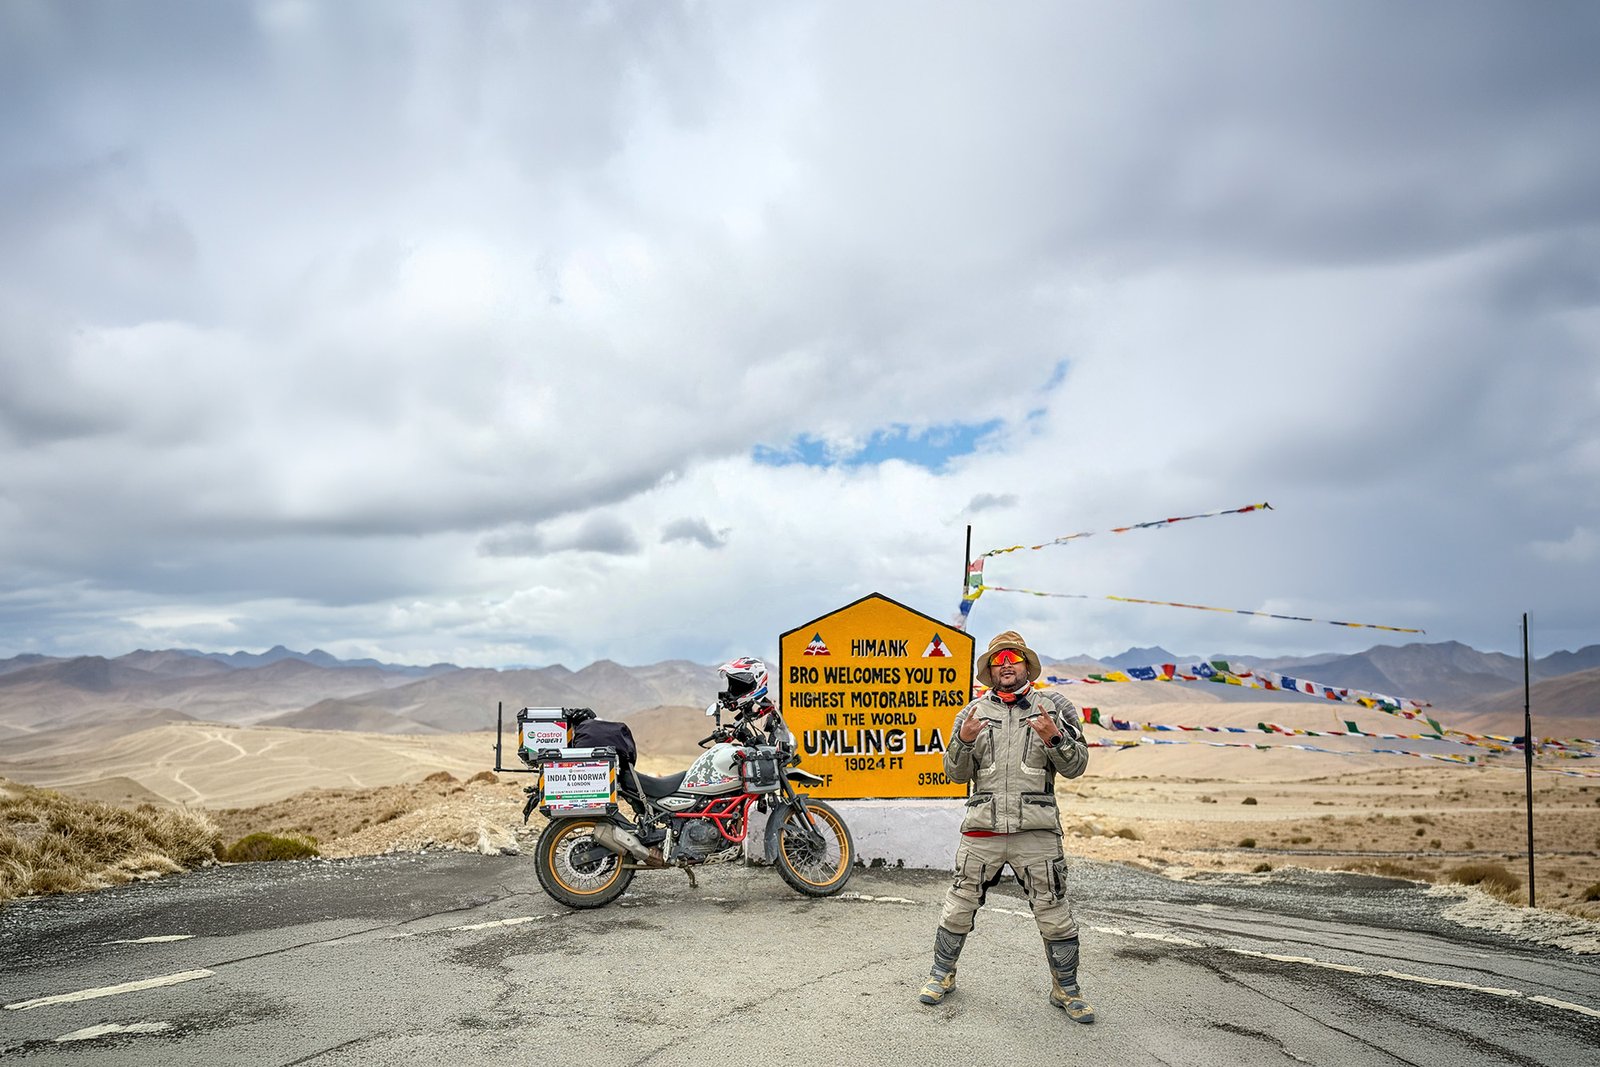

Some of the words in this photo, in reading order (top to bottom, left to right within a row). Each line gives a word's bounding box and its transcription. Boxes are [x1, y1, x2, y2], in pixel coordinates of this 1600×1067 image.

[851, 639, 908, 657] HIMANK
[790, 667, 818, 684] BRO
[824, 667, 900, 684] WELCOMES
[905, 668, 933, 683] YOU
[938, 668, 956, 683] TO
[790, 692, 845, 708] HIGHEST
[851, 691, 928, 708] MOTORABLE
[932, 690, 964, 707] PASS
[826, 713, 837, 726] IN
[843, 713, 865, 726] THE
[871, 713, 916, 726] WORLD
[804, 729, 906, 756] UMLING
[914, 728, 945, 755] LA
[845, 757, 885, 770] 19024
[890, 757, 904, 769] FT
[578, 772, 606, 780] NORWAY
